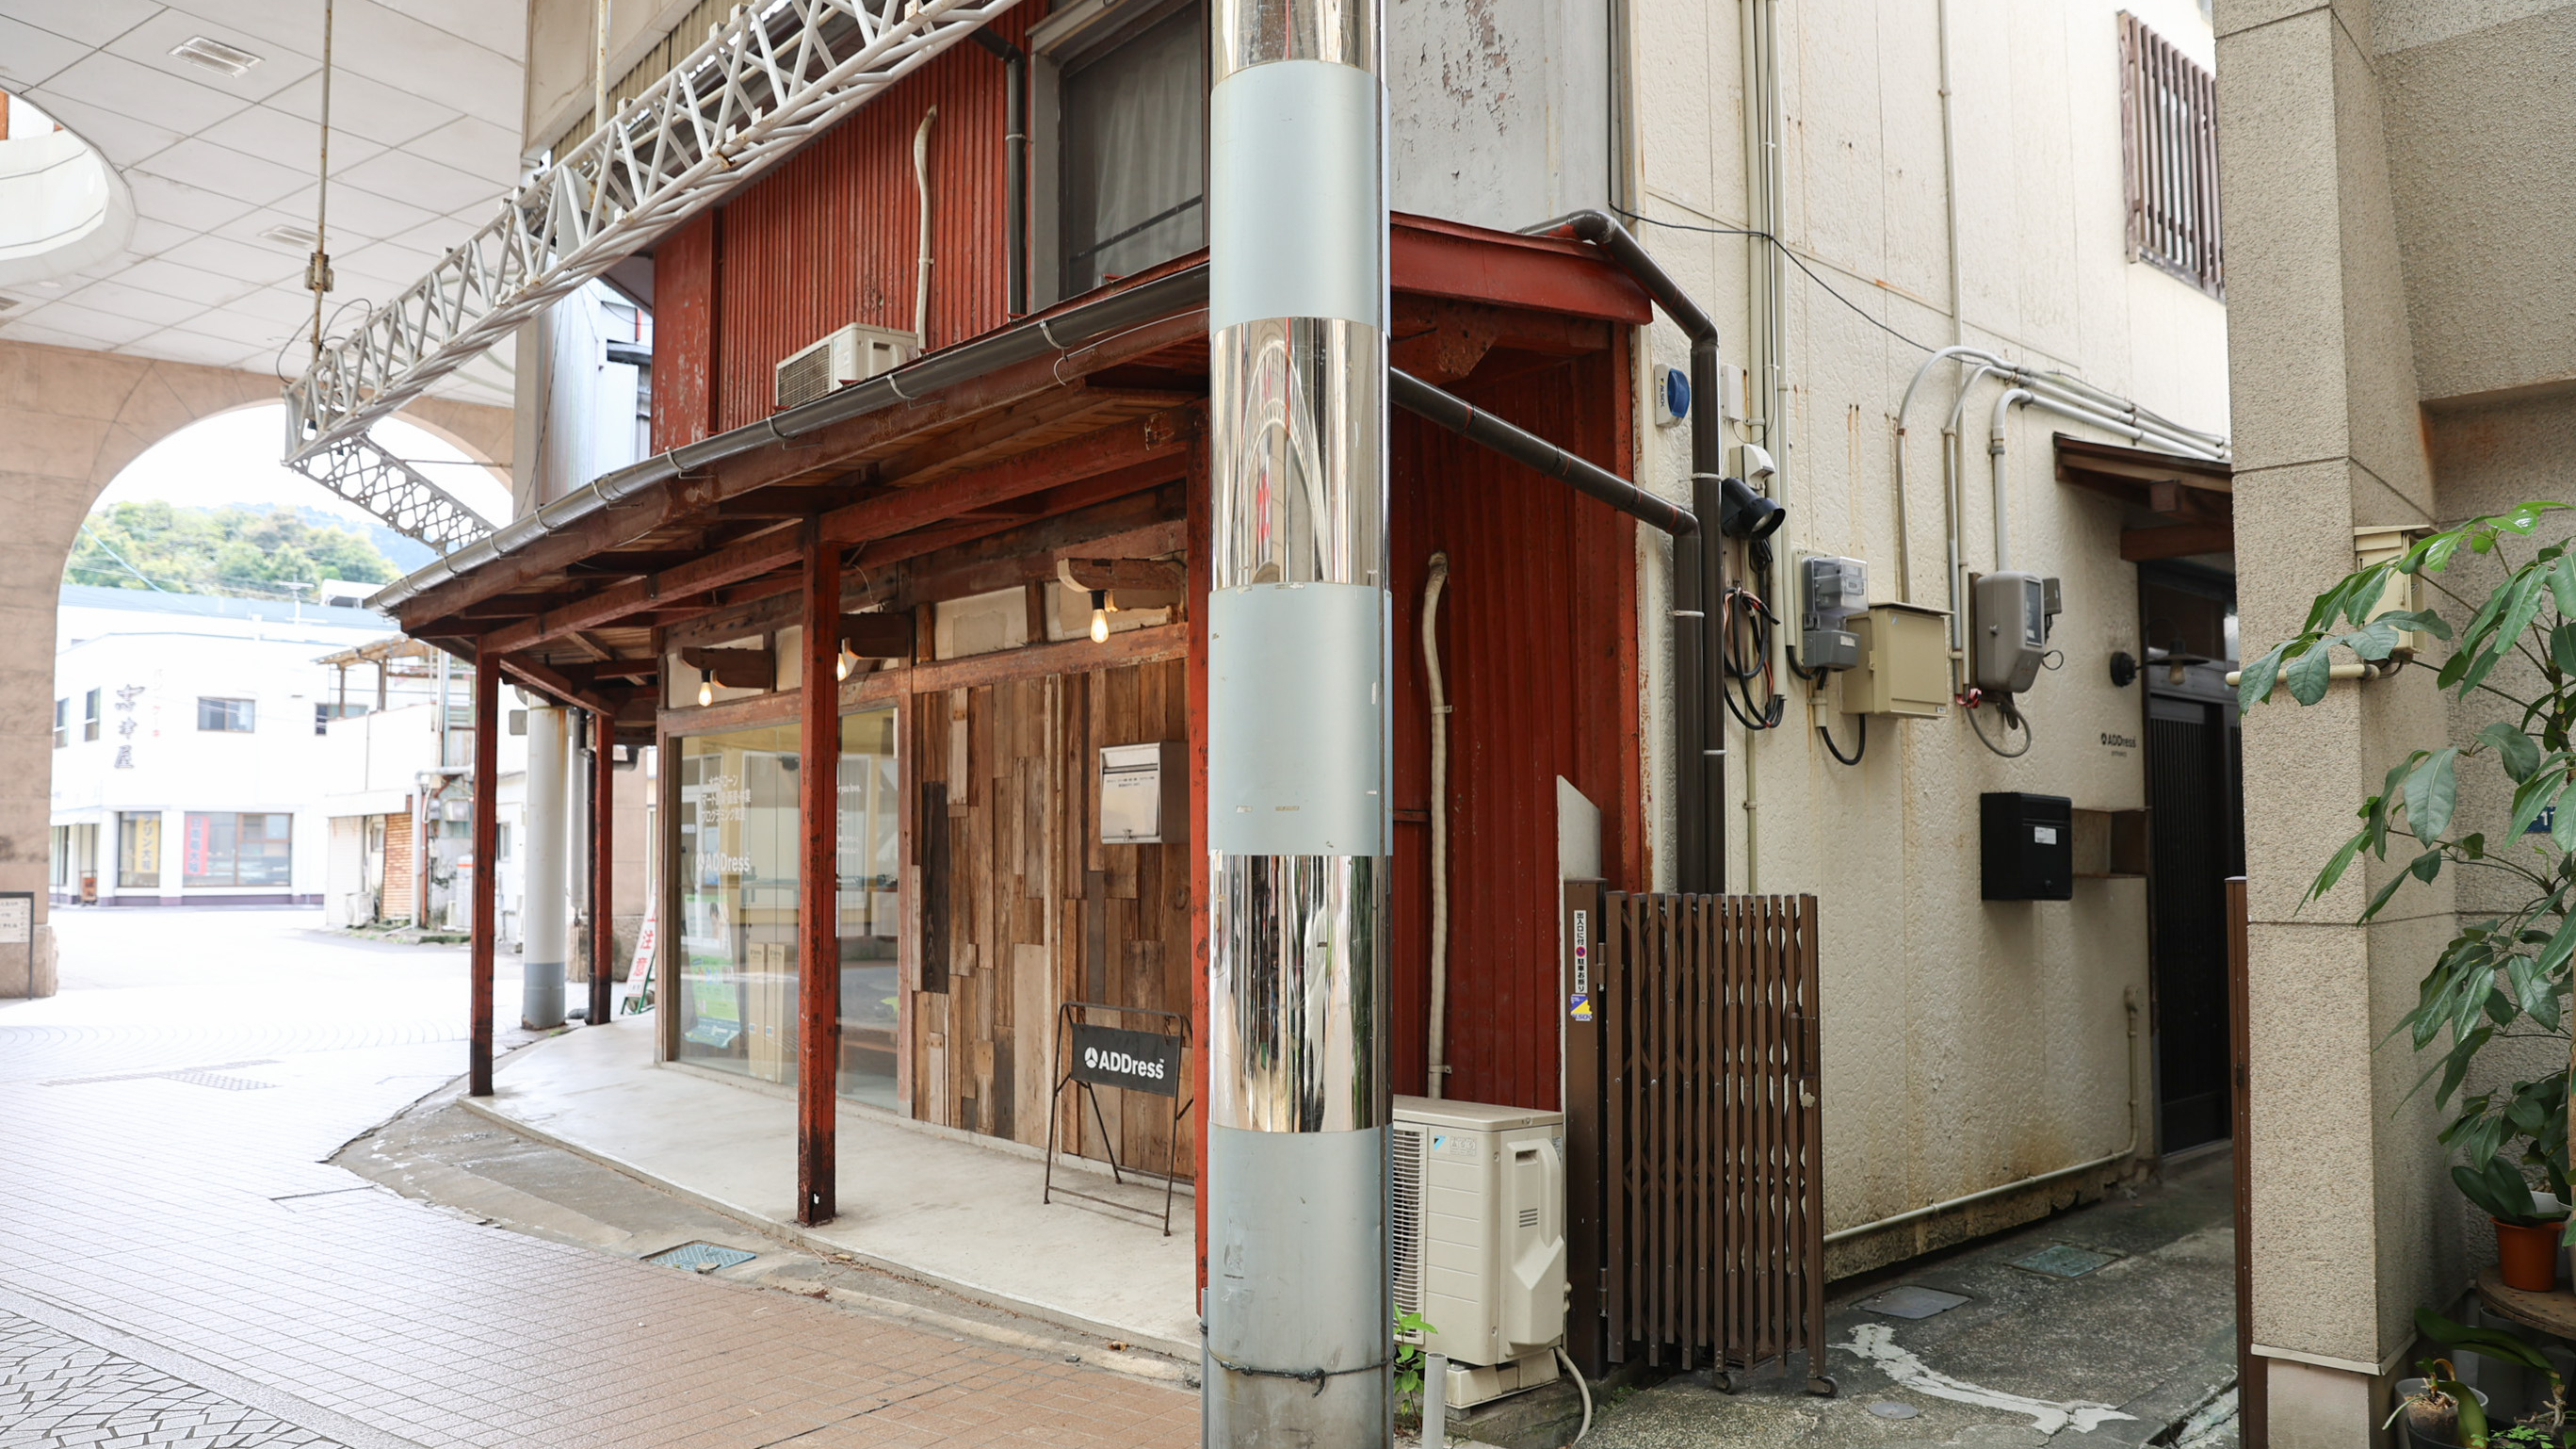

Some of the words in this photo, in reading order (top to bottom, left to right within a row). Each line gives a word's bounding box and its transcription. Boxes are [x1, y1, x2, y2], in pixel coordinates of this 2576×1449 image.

[2108, 734, 2136, 748] ADDress
[705, 852, 750, 871] ADDress
[1098, 1050, 1164, 1080] ADDress
